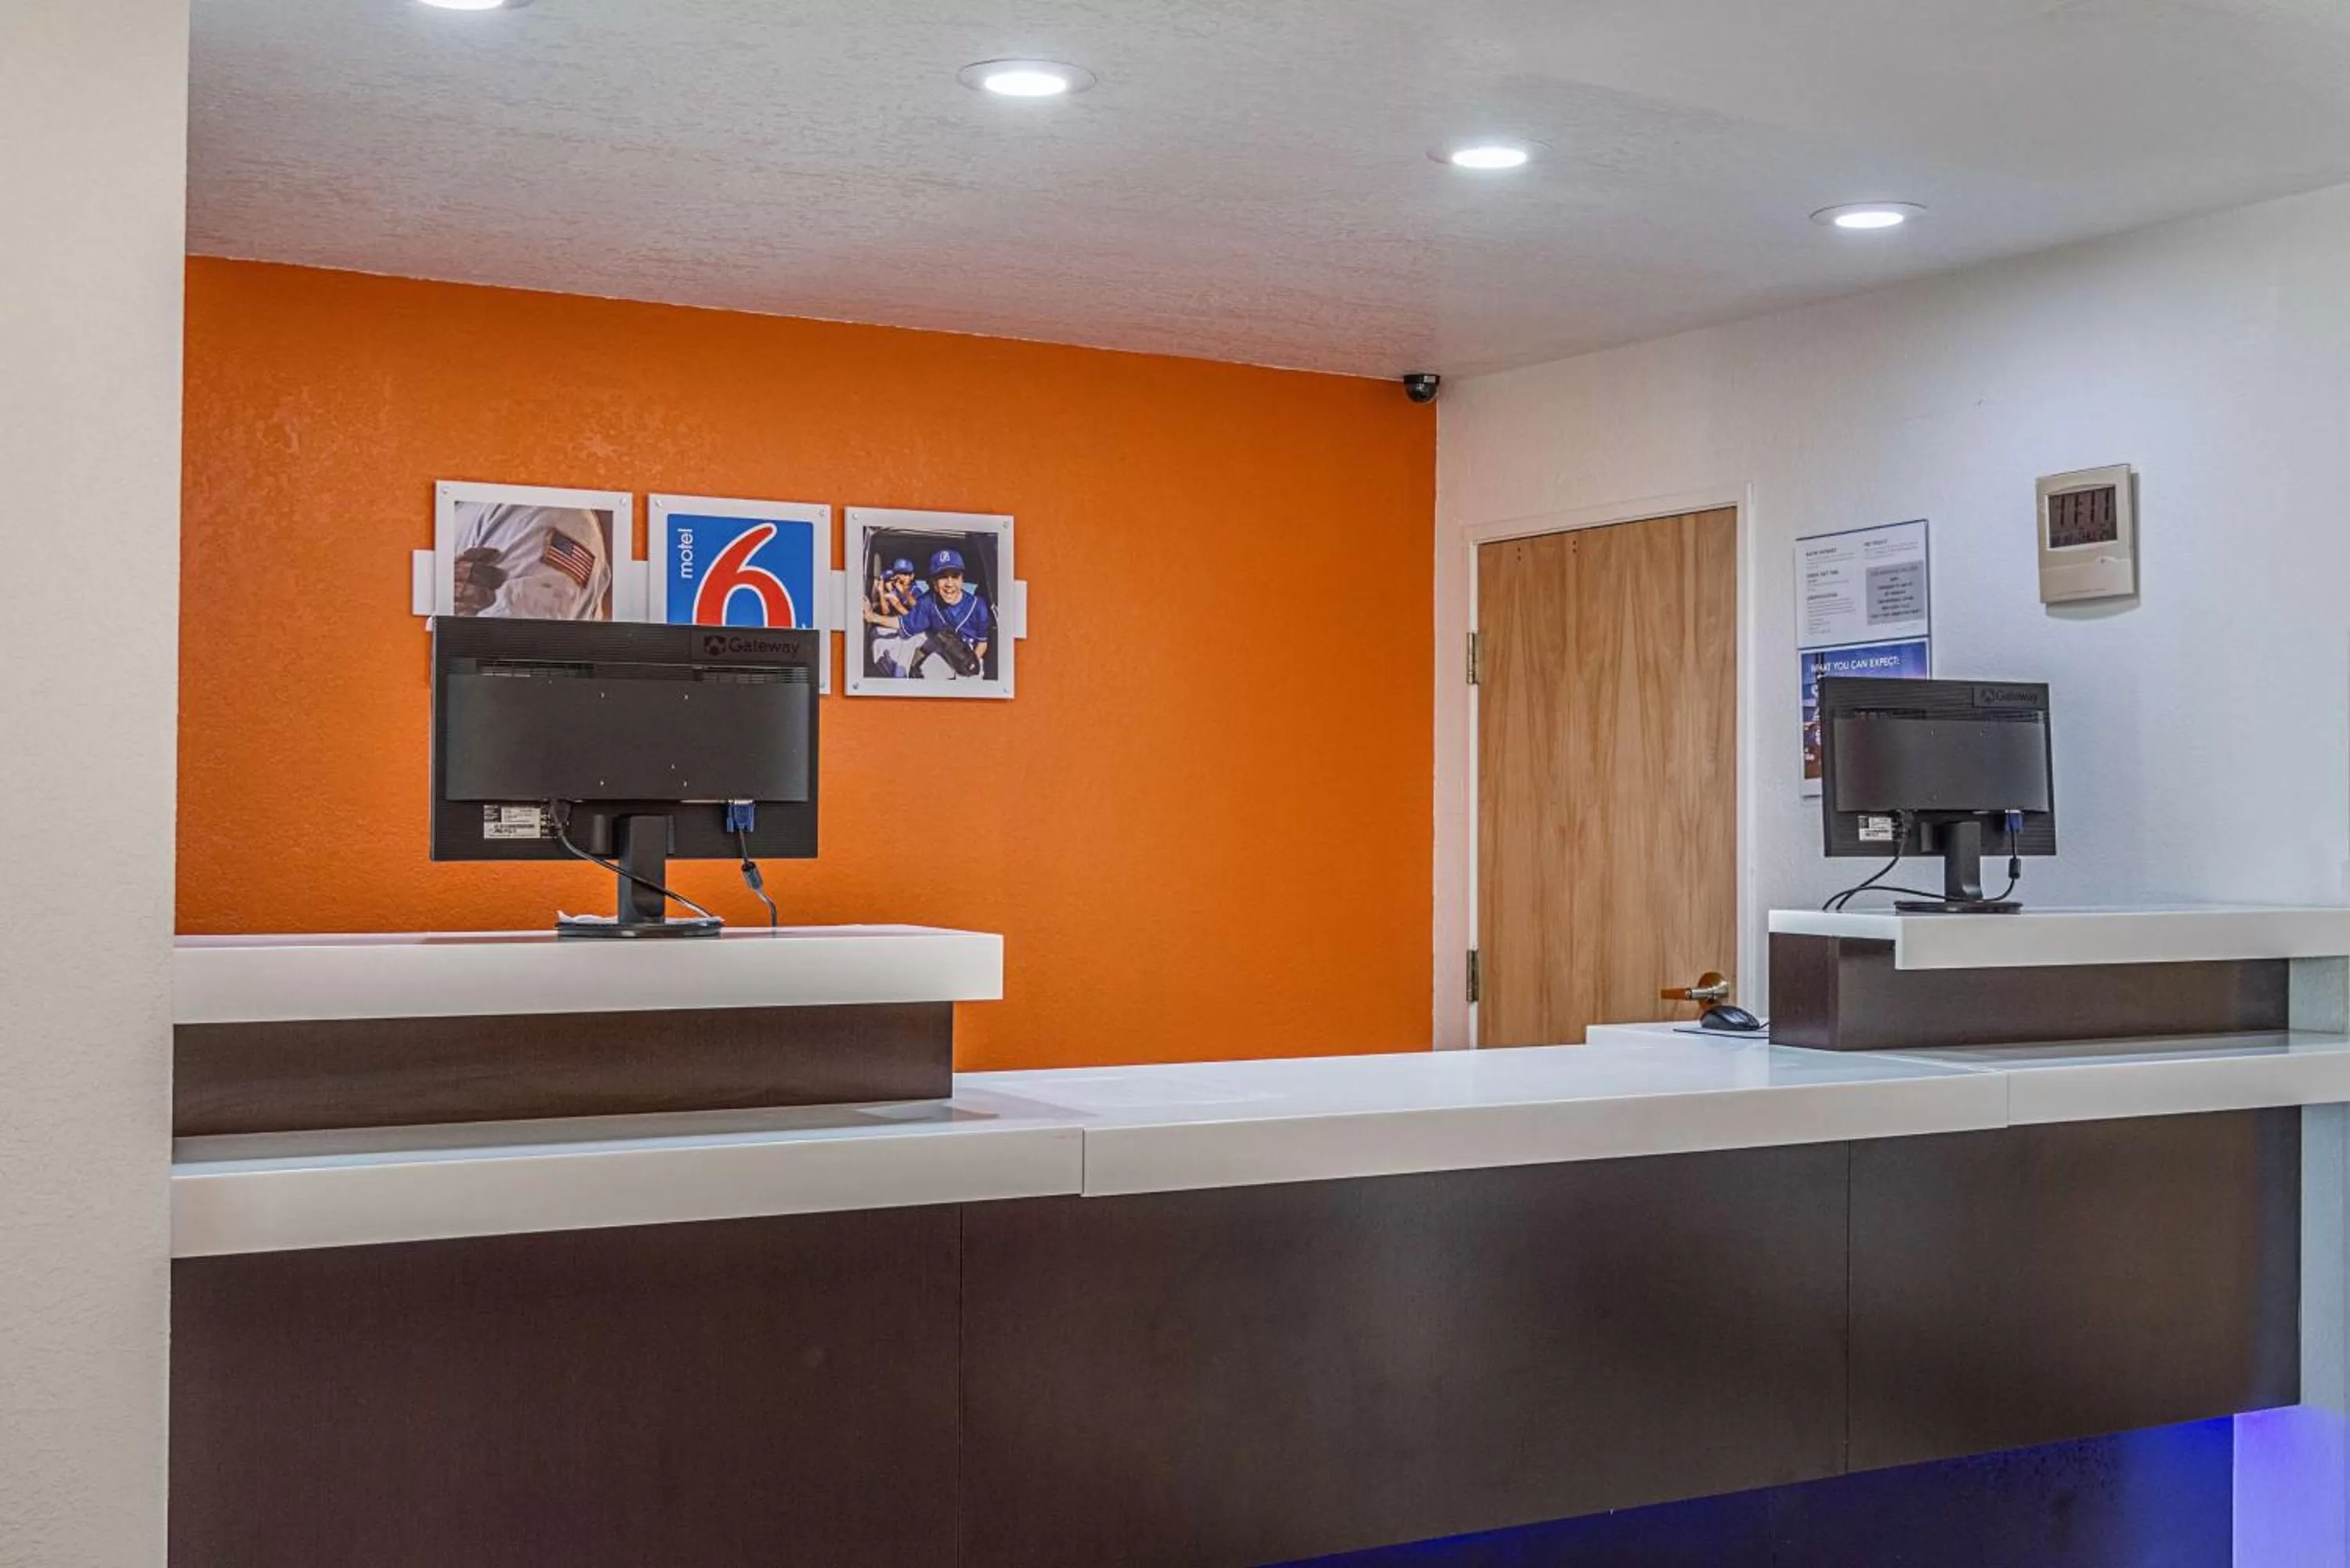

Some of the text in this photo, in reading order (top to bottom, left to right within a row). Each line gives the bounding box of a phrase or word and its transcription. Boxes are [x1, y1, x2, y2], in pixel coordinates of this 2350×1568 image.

[678, 528, 693, 579] motel
[692, 522, 796, 629] 6
[728, 637, 800, 659] Gateway
[1833, 661, 1849, 671] YOU
[1851, 659, 1868, 670] CAN
